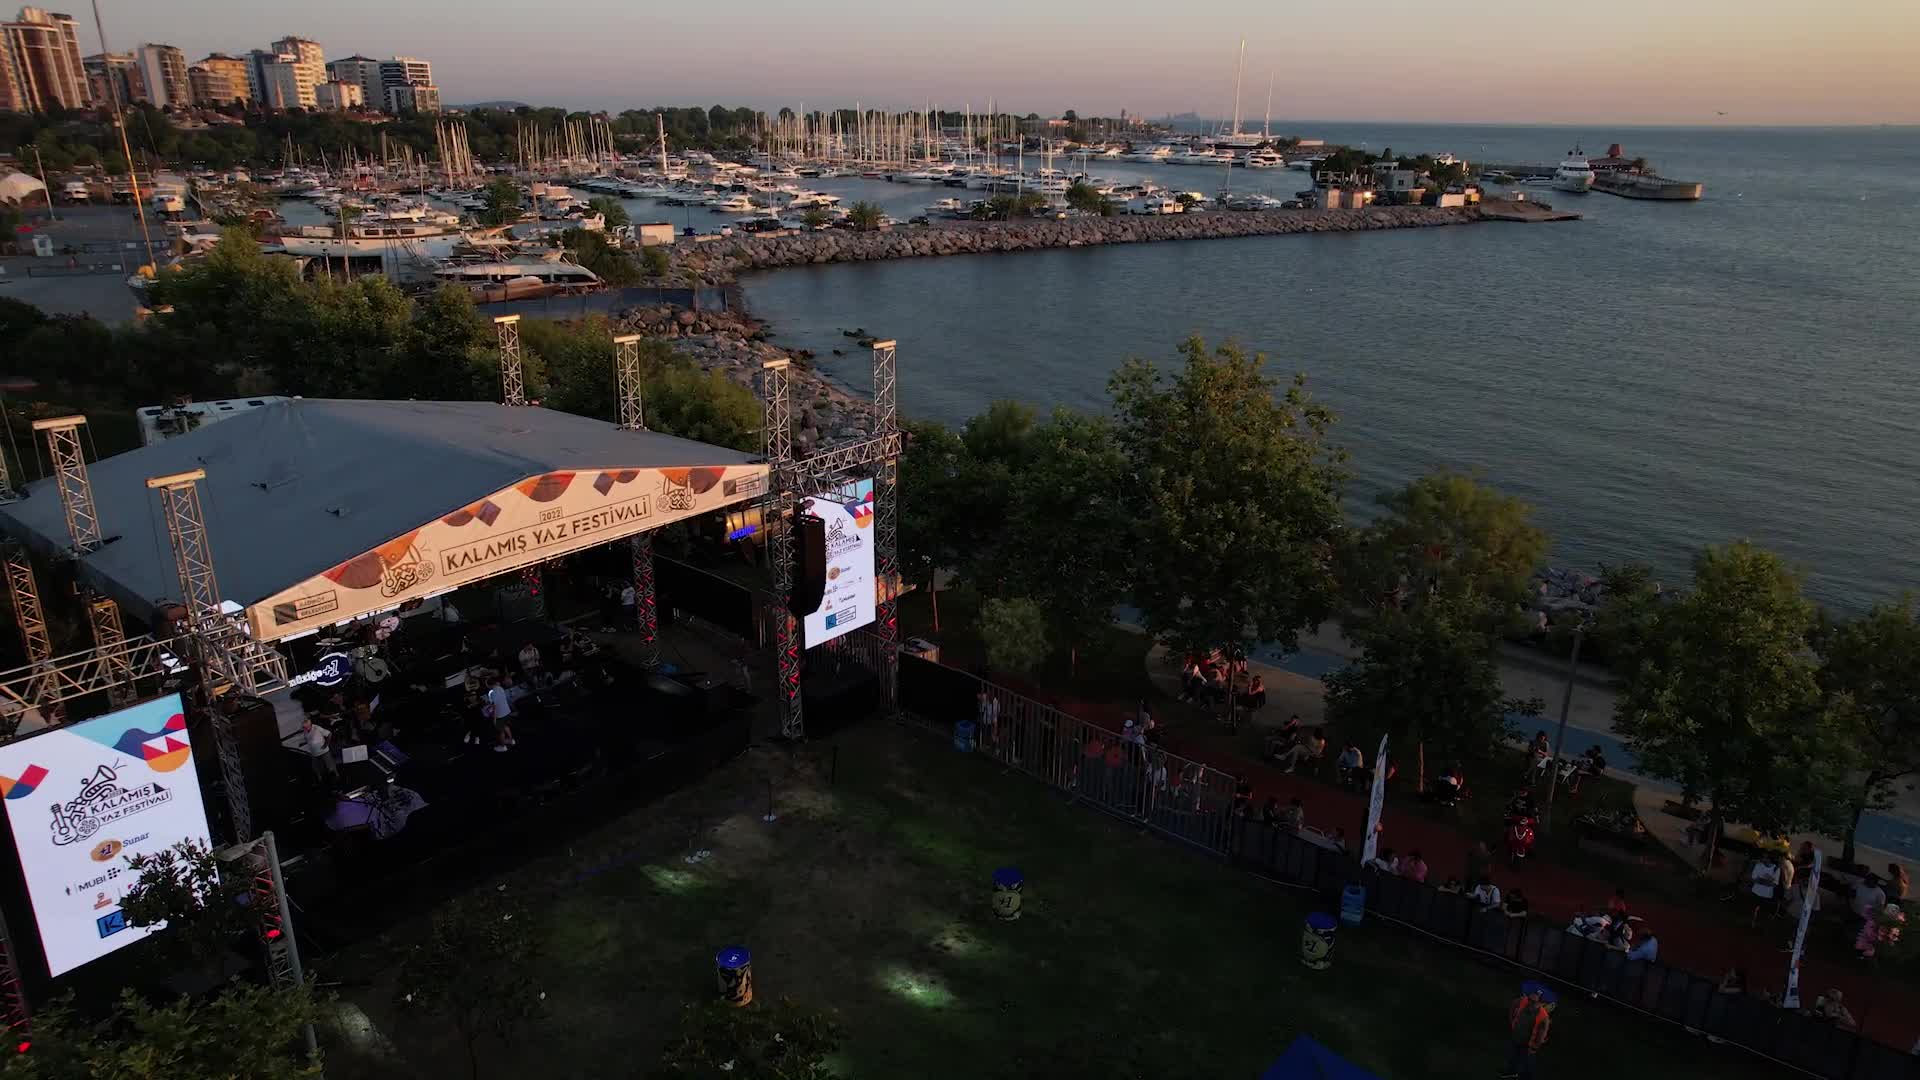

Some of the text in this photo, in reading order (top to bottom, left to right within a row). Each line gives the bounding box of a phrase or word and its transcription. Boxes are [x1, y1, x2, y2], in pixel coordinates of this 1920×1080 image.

[541, 508, 561, 522] 2022
[446, 497, 648, 572] KALAMIŞ YAZ FESTİVALİ
[90, 786, 151, 815] KALAMIŞ
[100, 791, 169, 823] YAZ FESTİVALİ
[122, 831, 150, 848] Sunar
[79, 875, 106, 892] MUBI
